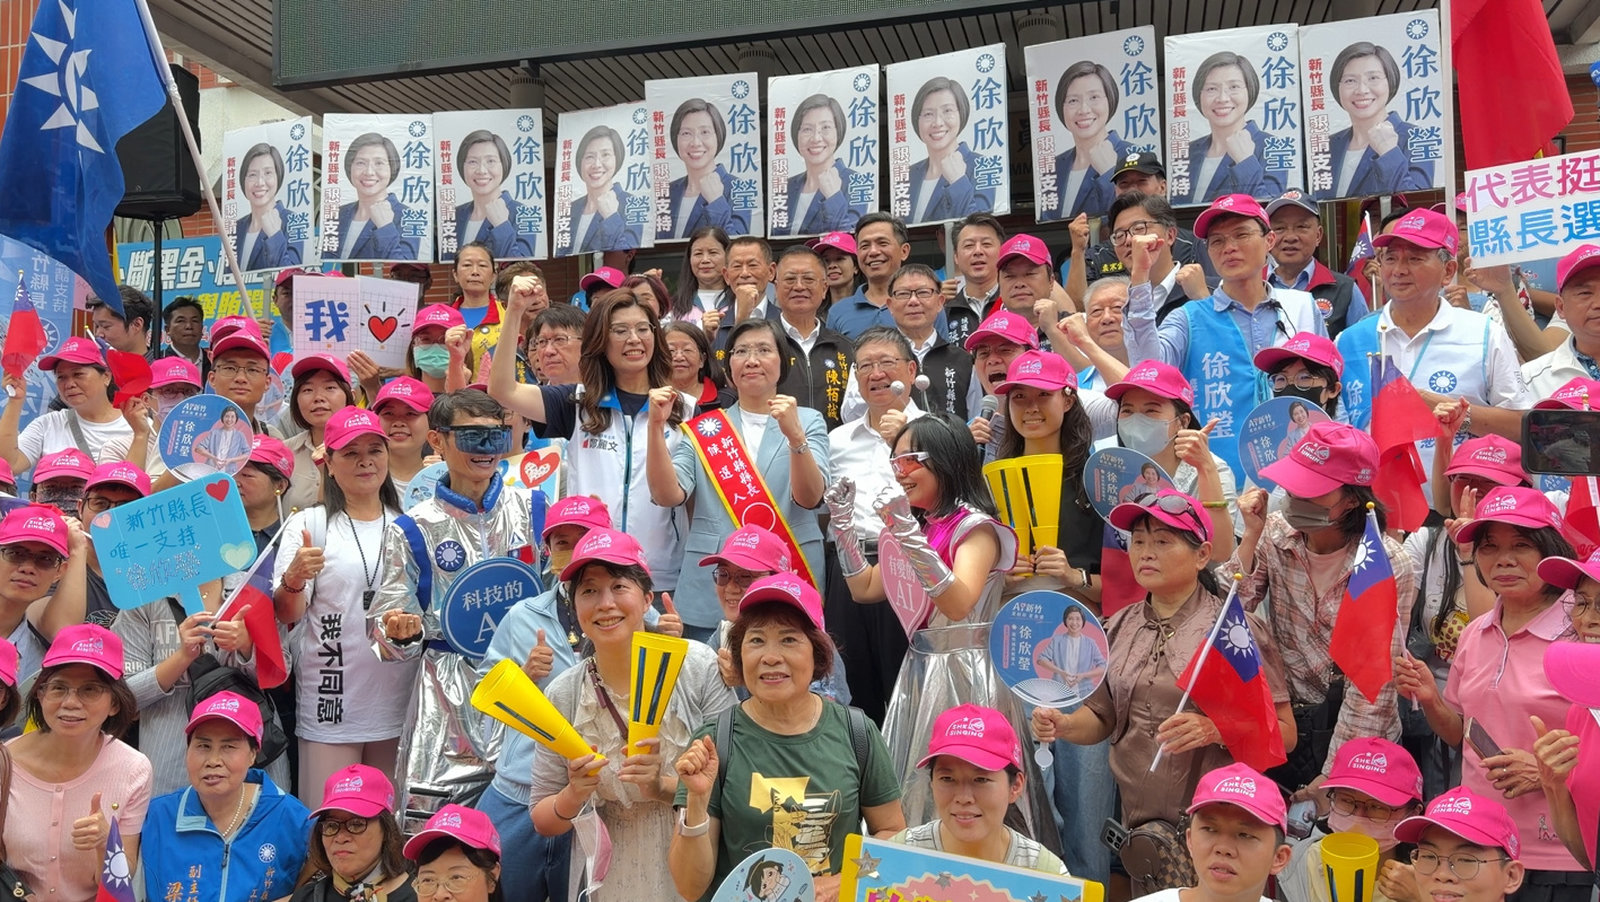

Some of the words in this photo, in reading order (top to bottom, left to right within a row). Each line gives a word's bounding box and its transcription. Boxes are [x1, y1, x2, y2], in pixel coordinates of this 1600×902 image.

[1035, 80, 1051, 132] 新竹縣長
[1173, 67, 1186, 118] 新竹縣長
[1262, 57, 1297, 172] 徐欣瑩
[1308, 58, 1325, 111] 新竹縣長
[1402, 45, 1443, 163] 徐欣瑩
[653, 111, 666, 159] 新竹縣長
[774, 108, 786, 154] 新竹縣長
[893, 94, 906, 143] 新竹縣長
[971, 77, 1003, 190] 徐欣瑩
[327, 141, 340, 184] 新竹縣長
[439, 141, 453, 184] 新竹縣長
[561, 140, 572, 182] 新竹縣長
[625, 128, 649, 225] 徐欣瑩
[728, 104, 758, 211] 徐欣瑩
[848, 97, 877, 206] 徐欣瑩
[892, 147, 910, 217] 懇請支持
[1037, 136, 1058, 211] 懇請支持
[1170, 121, 1190, 196] 懇請支持
[1308, 115, 1333, 191] 懇請支持
[285, 143, 310, 244] 徐欣瑩
[401, 141, 431, 238] 徐欣瑩
[512, 136, 543, 235] 徐欣瑩
[557, 184, 572, 248] 懇請支持
[654, 163, 672, 232] 懇請支持
[772, 158, 789, 229] 懇請支持
[1466, 155, 1600, 213] 代表挺
[321, 188, 341, 253] 懇請支持
[440, 188, 457, 253] 懇請支持
[1469, 199, 1600, 258] 縣長選
[304, 299, 349, 342] 我
[1202, 351, 1235, 440] 徐欣瑩
[180, 421, 195, 457] 徐欣瑩
[126, 490, 211, 532] 新竹縣長
[1107, 471, 1118, 507] 徐欣瑩
[110, 528, 197, 559] 唯一支持
[462, 580, 523, 611] 科技的
[896, 581, 914, 612] AI
[317, 612, 344, 724] 我不同意
[1018, 625, 1031, 671] 徐欣瑩
